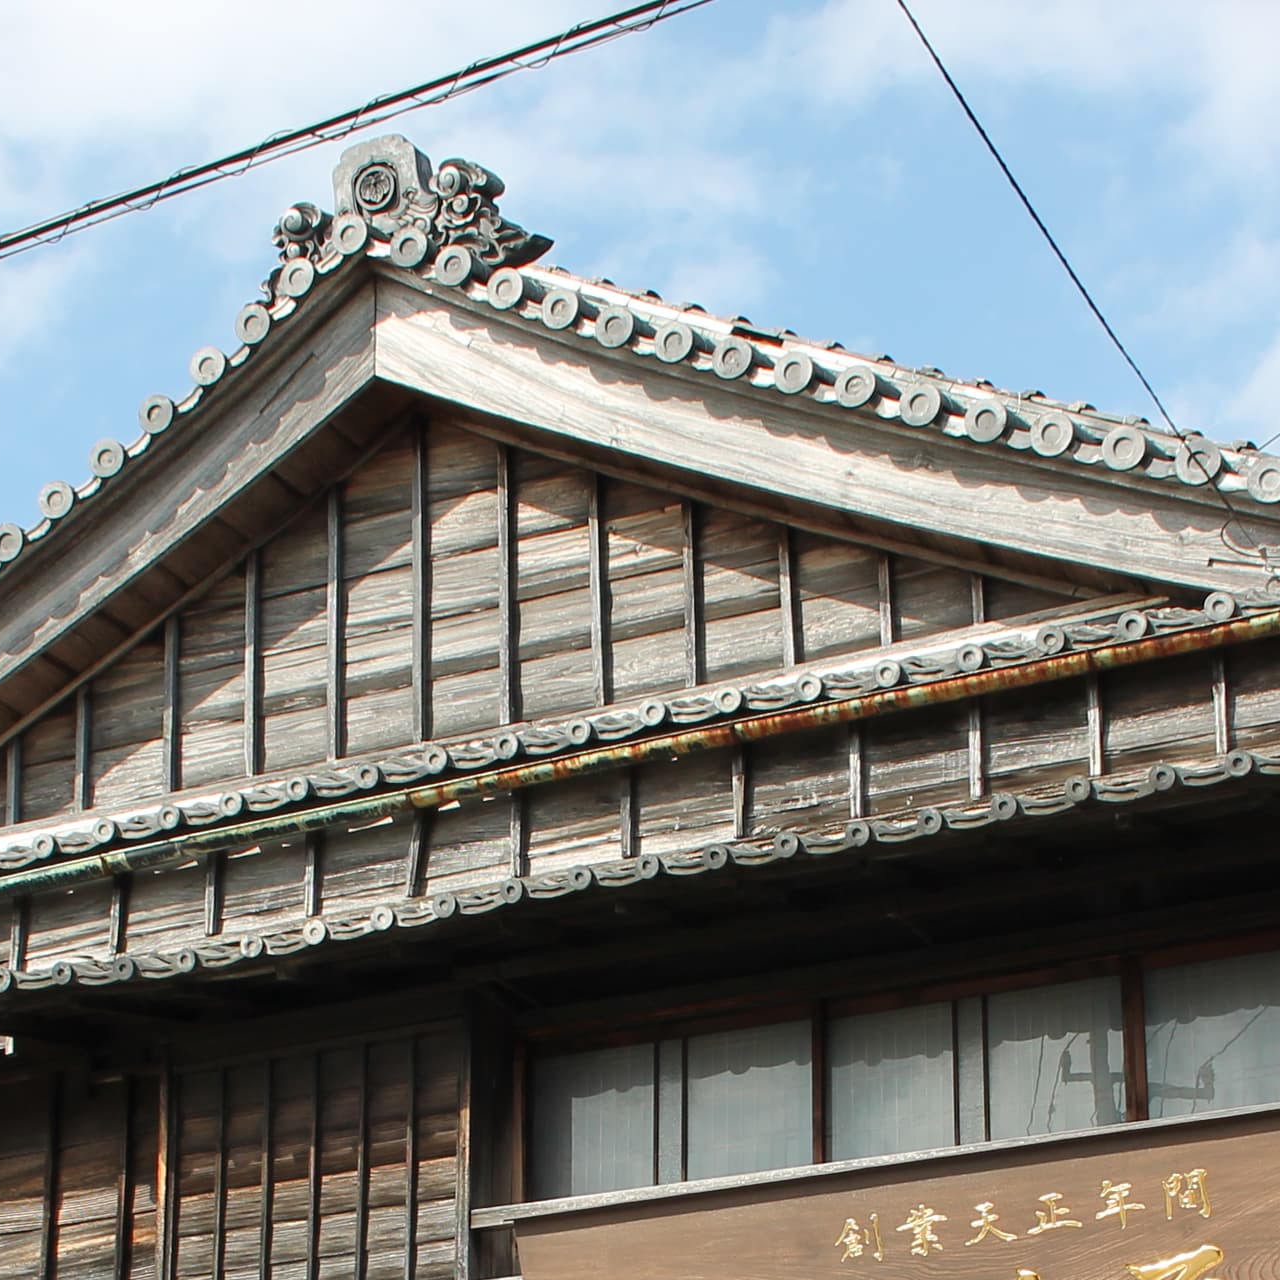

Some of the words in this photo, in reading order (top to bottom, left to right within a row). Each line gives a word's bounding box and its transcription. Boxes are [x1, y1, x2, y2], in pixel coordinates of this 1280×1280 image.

[834, 1167, 1213, 1263] 創業天正年間
